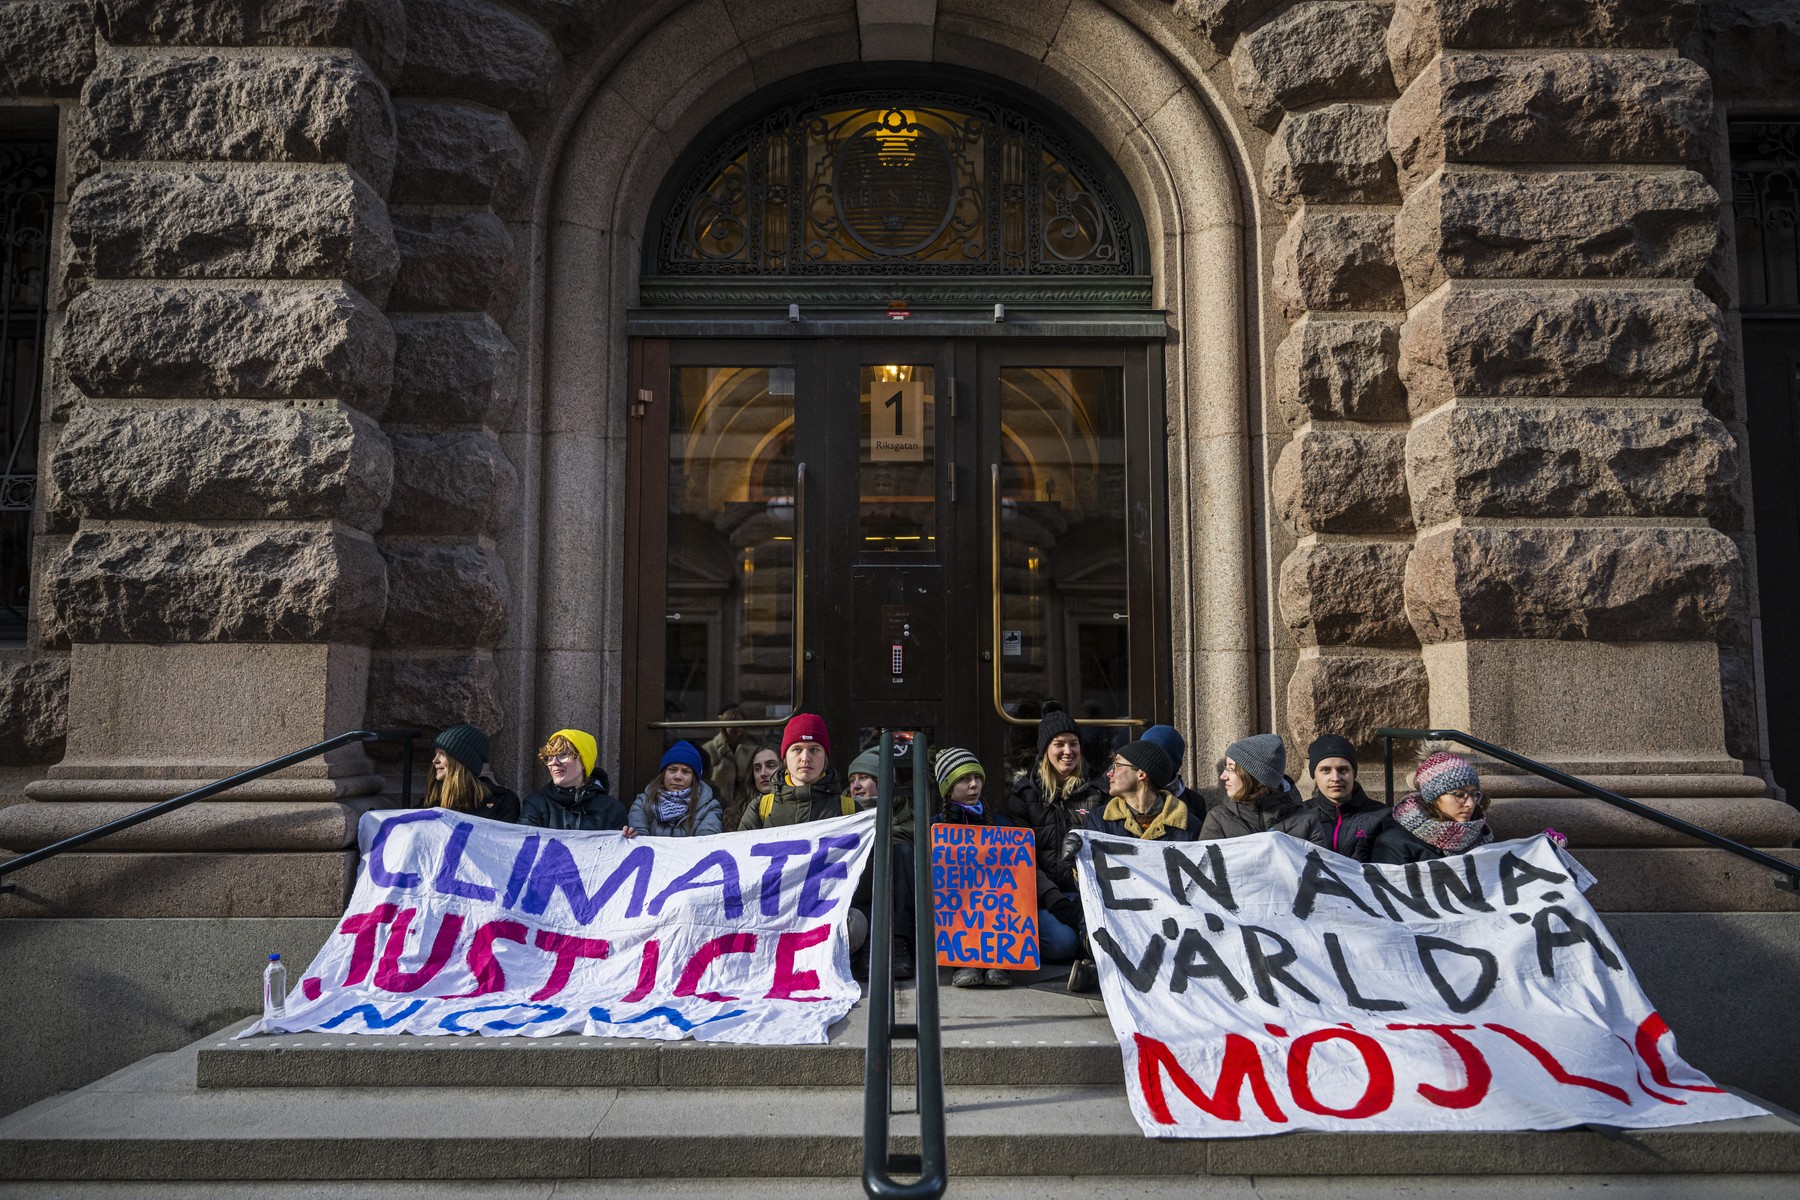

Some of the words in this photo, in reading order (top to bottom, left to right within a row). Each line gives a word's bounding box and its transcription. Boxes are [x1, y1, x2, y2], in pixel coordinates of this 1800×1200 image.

[885, 390, 903, 436] 1
[876, 441, 918, 452] Riksgatan
[934, 827, 976, 845] HUR
[981, 826, 1035, 847] MÅNGA
[369, 809, 860, 925] CLIMATE
[933, 845, 978, 866] FLER
[985, 846, 1033, 867] SKA
[933, 864, 1018, 890] BEHÖVA
[1090, 839, 1240, 914] EN
[1292, 849, 1578, 922] ANNA
[970, 889, 1018, 913] FÖR
[961, 909, 984, 930] VI
[992, 913, 1036, 936] SKA
[303, 903, 832, 1002] JUSTICE
[936, 931, 1040, 967] AGERA
[1092, 912, 1499, 1014] VÄRLD
[318, 999, 747, 1032] NOW
